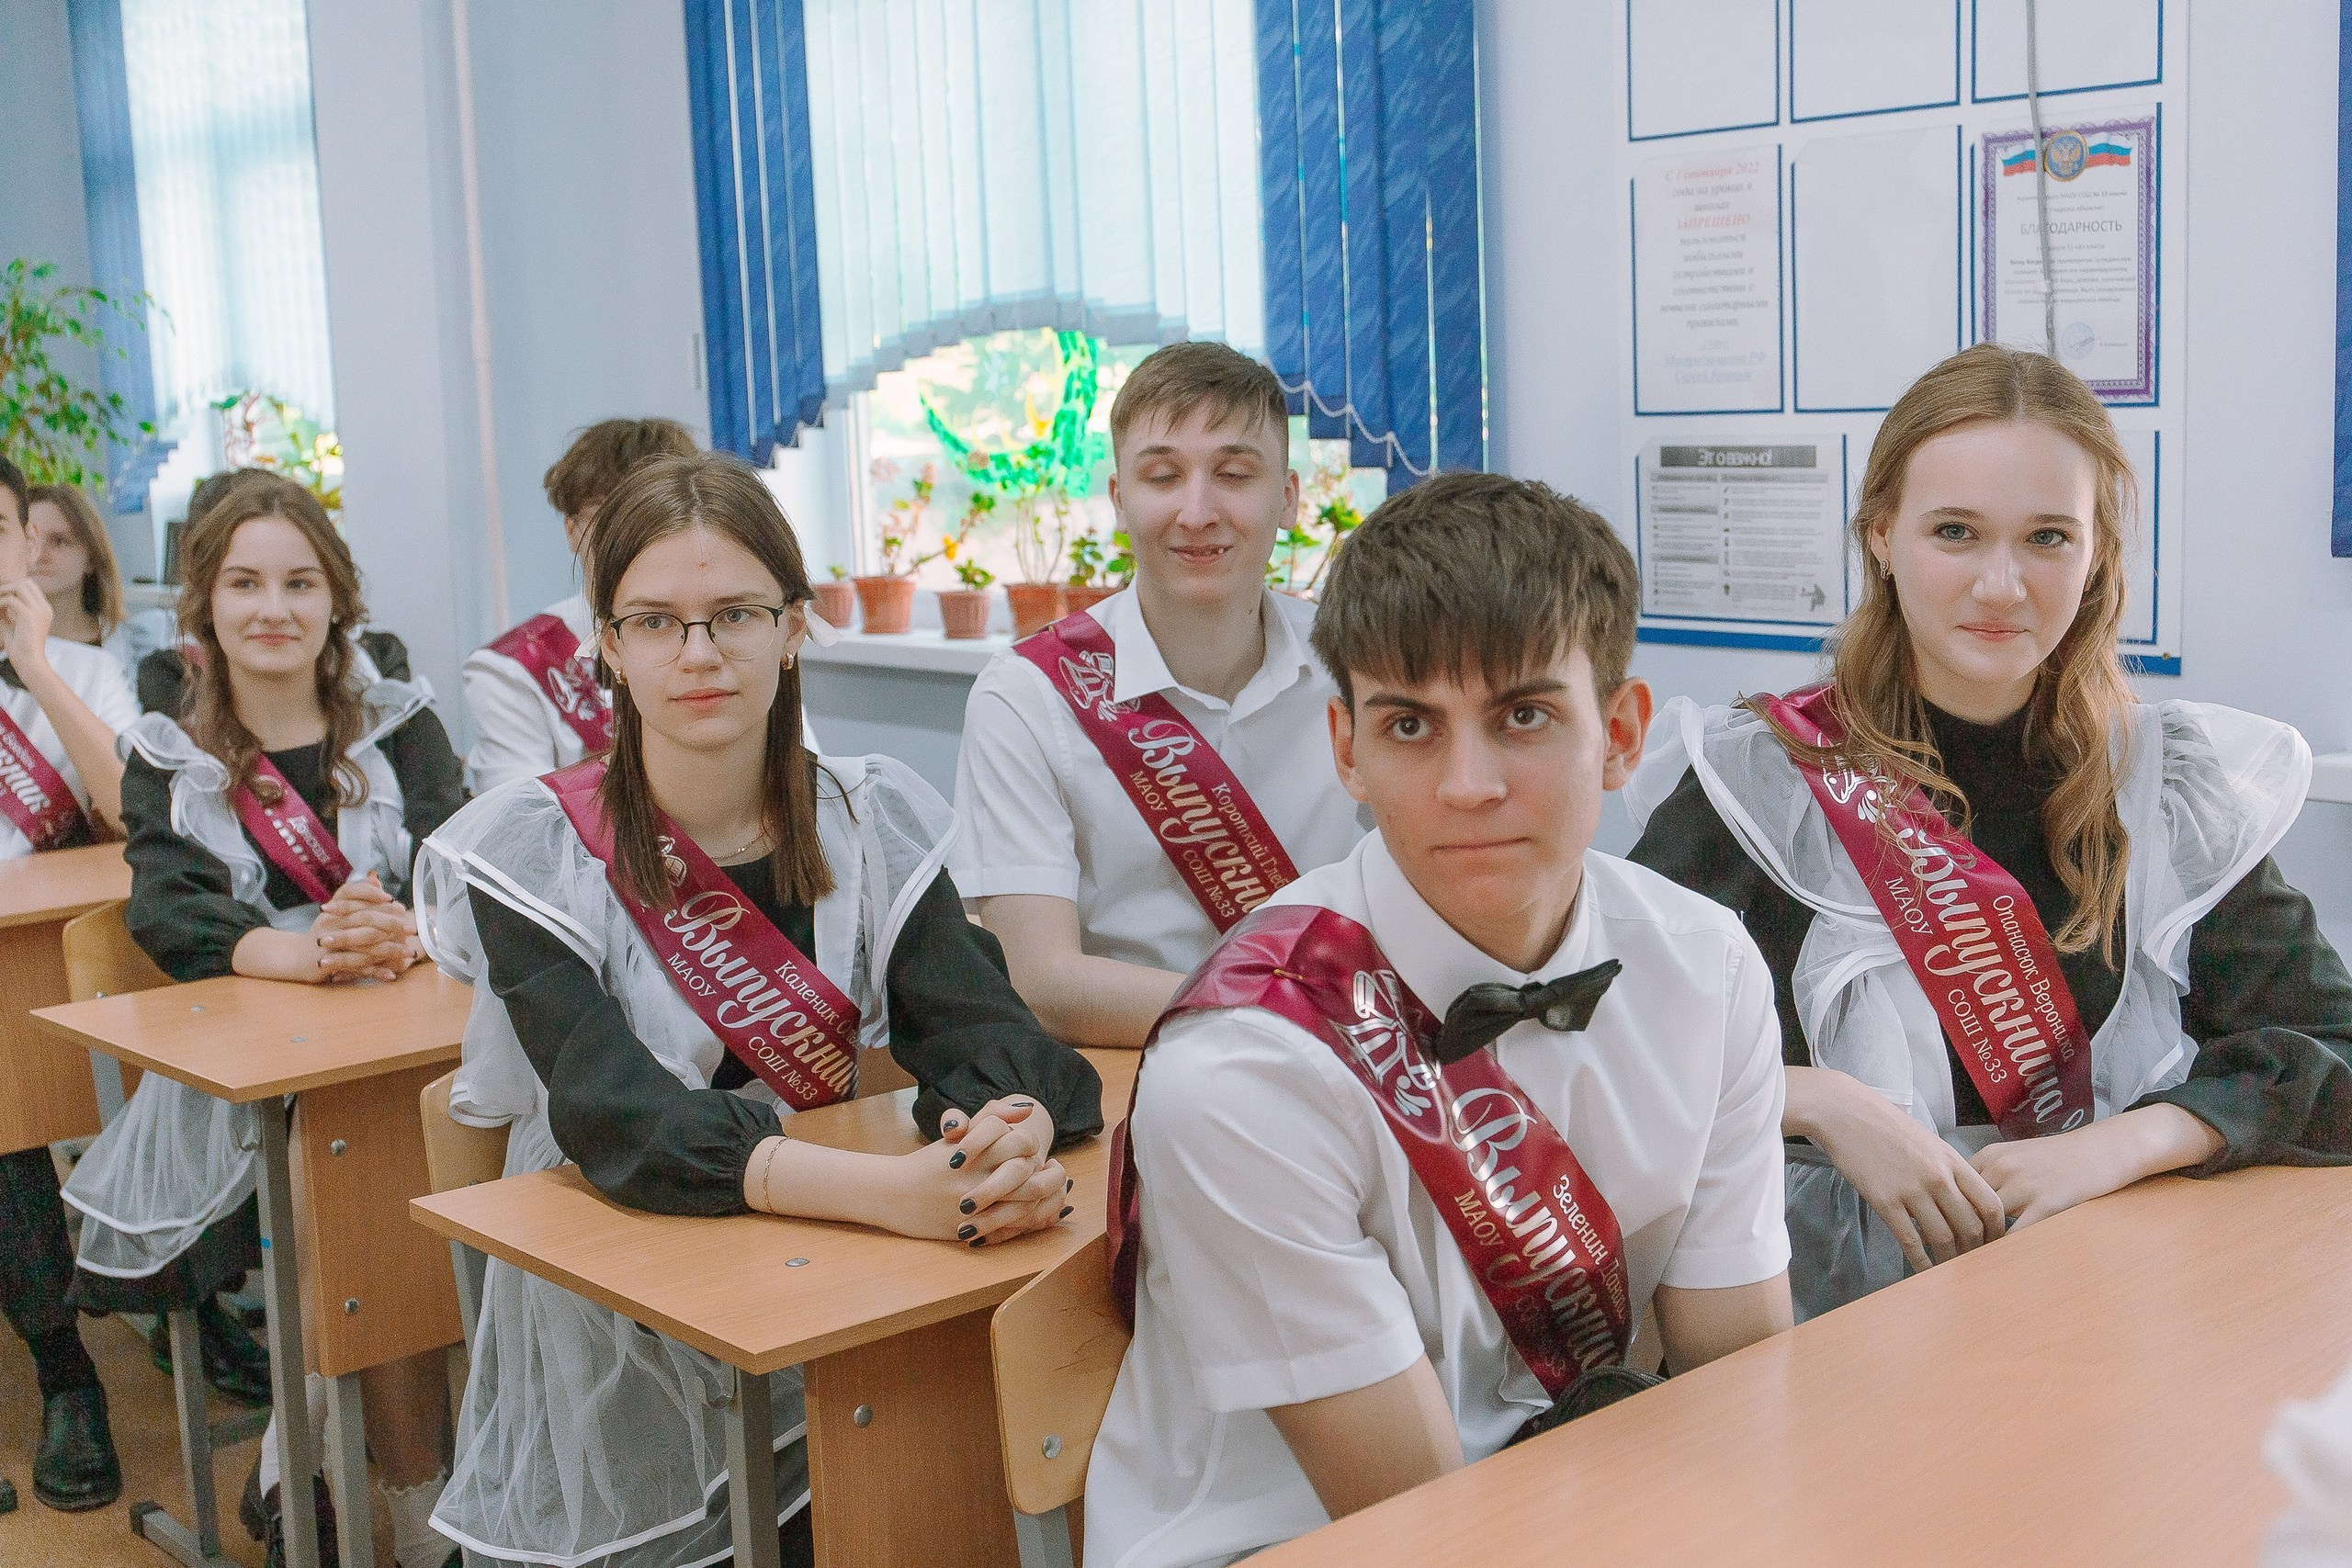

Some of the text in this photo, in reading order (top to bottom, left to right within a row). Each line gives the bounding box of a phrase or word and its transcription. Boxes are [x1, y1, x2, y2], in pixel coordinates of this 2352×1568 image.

[2021, 220, 2122, 235] БЛАОДАРНОСТЬ
[1129, 770, 1235, 918] МАОУ СОШ №33
[1211, 783, 1269, 860] Короткий
[775, 960, 840, 1026] Каленик
[1884, 875, 2008, 1083] МАОУ СОШ №33
[1992, 895, 2075, 1062] Опанасюк Вероника
[668, 953, 818, 1100] МАОУ СОШ №33
[1454, 1189, 1505, 1248] МАОУ
[1553, 1173, 1608, 1266] Зеленин
